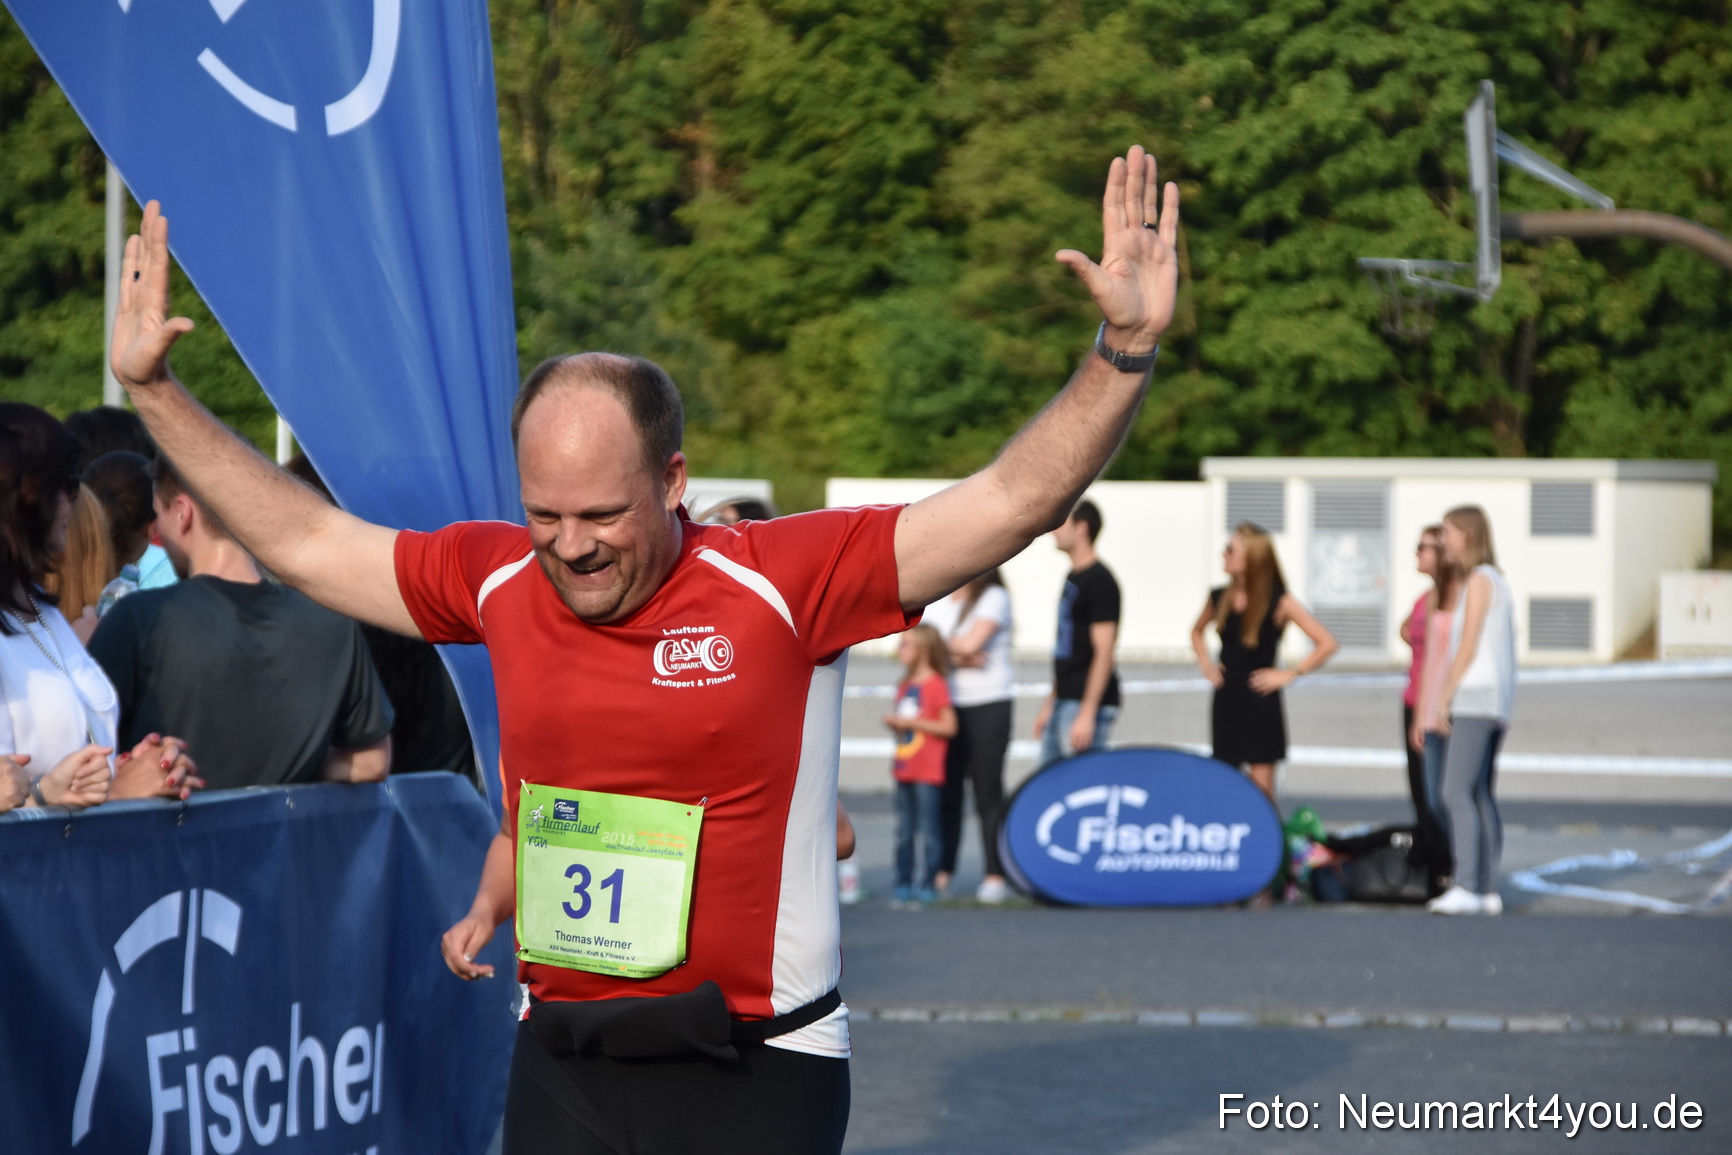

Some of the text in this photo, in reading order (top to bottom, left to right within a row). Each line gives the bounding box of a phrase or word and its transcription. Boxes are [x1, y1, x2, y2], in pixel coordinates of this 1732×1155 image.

[662, 625, 715, 636] Laufteam
[672, 638, 702, 661] ASV
[670, 661, 703, 670] NEUMARKT
[651, 672, 737, 688] Kraftsport & Fitness
[542, 815, 602, 835] firmenlauf
[1076, 812, 1251, 855] Fischer
[600, 831, 636, 846] 2015
[1094, 851, 1240, 873] AUTOMOBILE
[562, 863, 625, 924] 31
[555, 929, 633, 950] Thomas Werner
[559, 946, 583, 955] Neumarkt
[605, 952, 625, 960] Fitness
